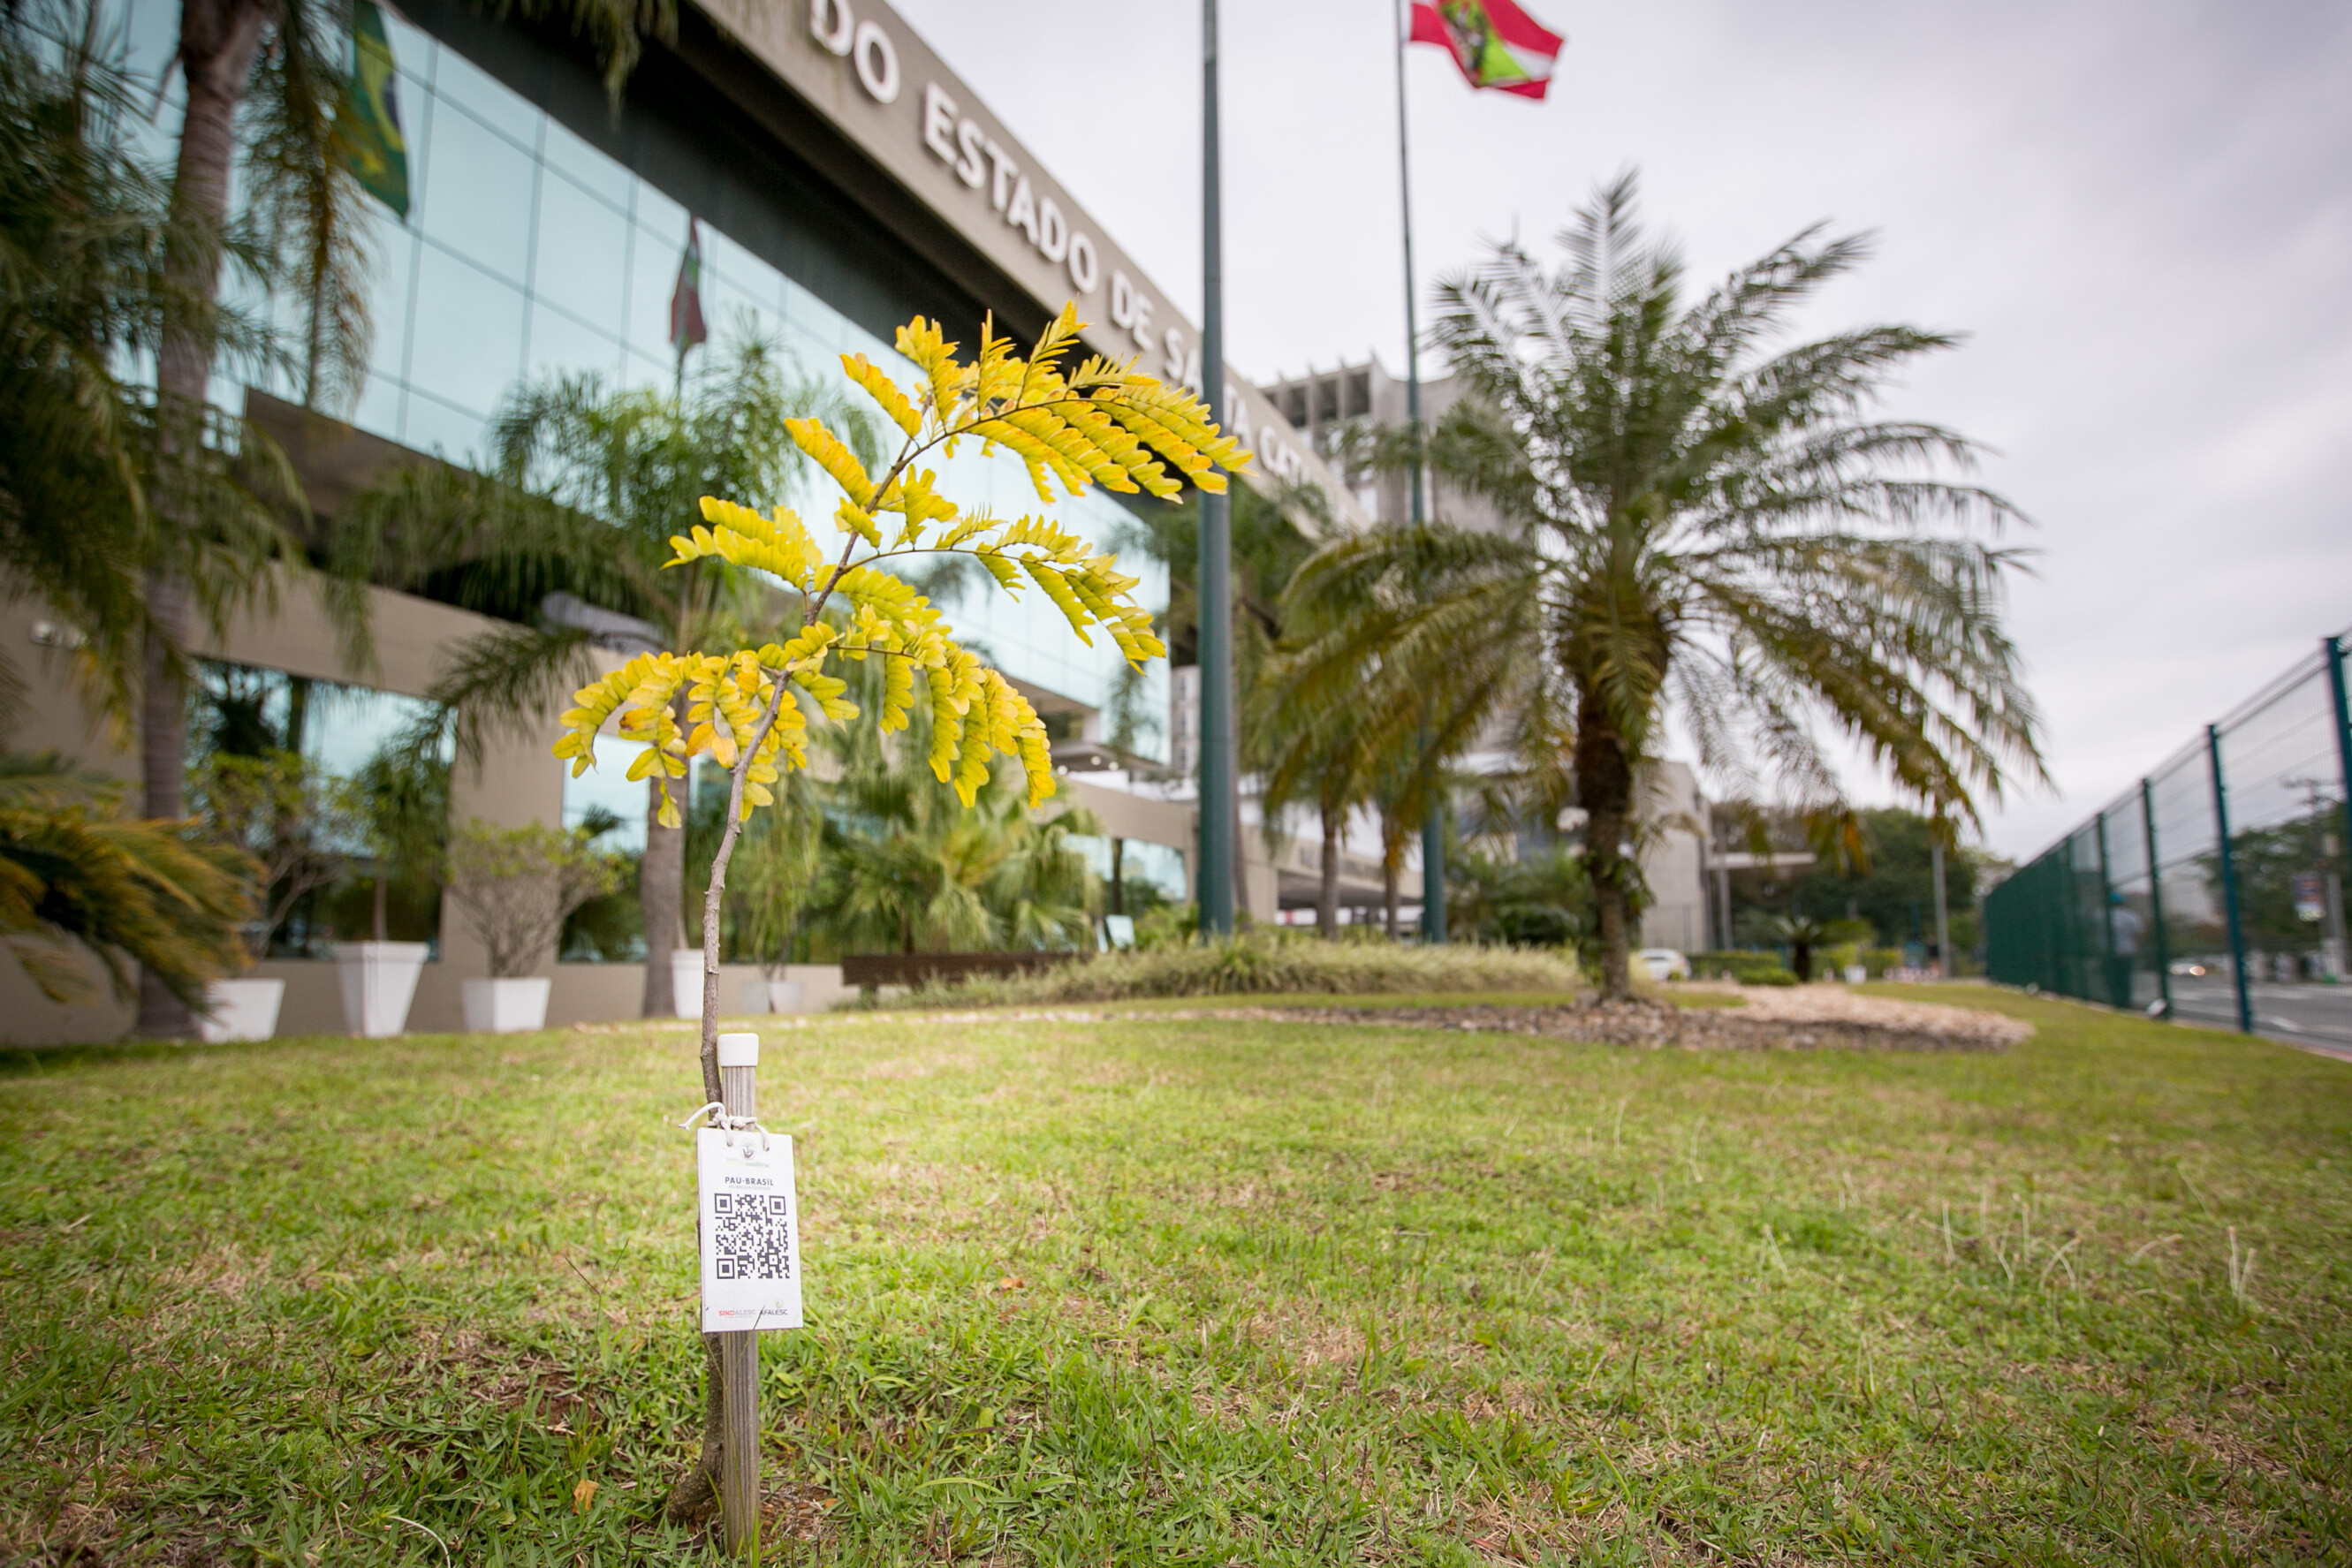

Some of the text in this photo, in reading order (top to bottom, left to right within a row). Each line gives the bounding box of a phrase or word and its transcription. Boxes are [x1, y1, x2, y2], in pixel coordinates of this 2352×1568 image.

[811, 0, 900, 104] DO
[925, 81, 1099, 294] ESTADO
[1112, 269, 1154, 352] DE
[725, 1176, 774, 1186] PAU-BRASIL
